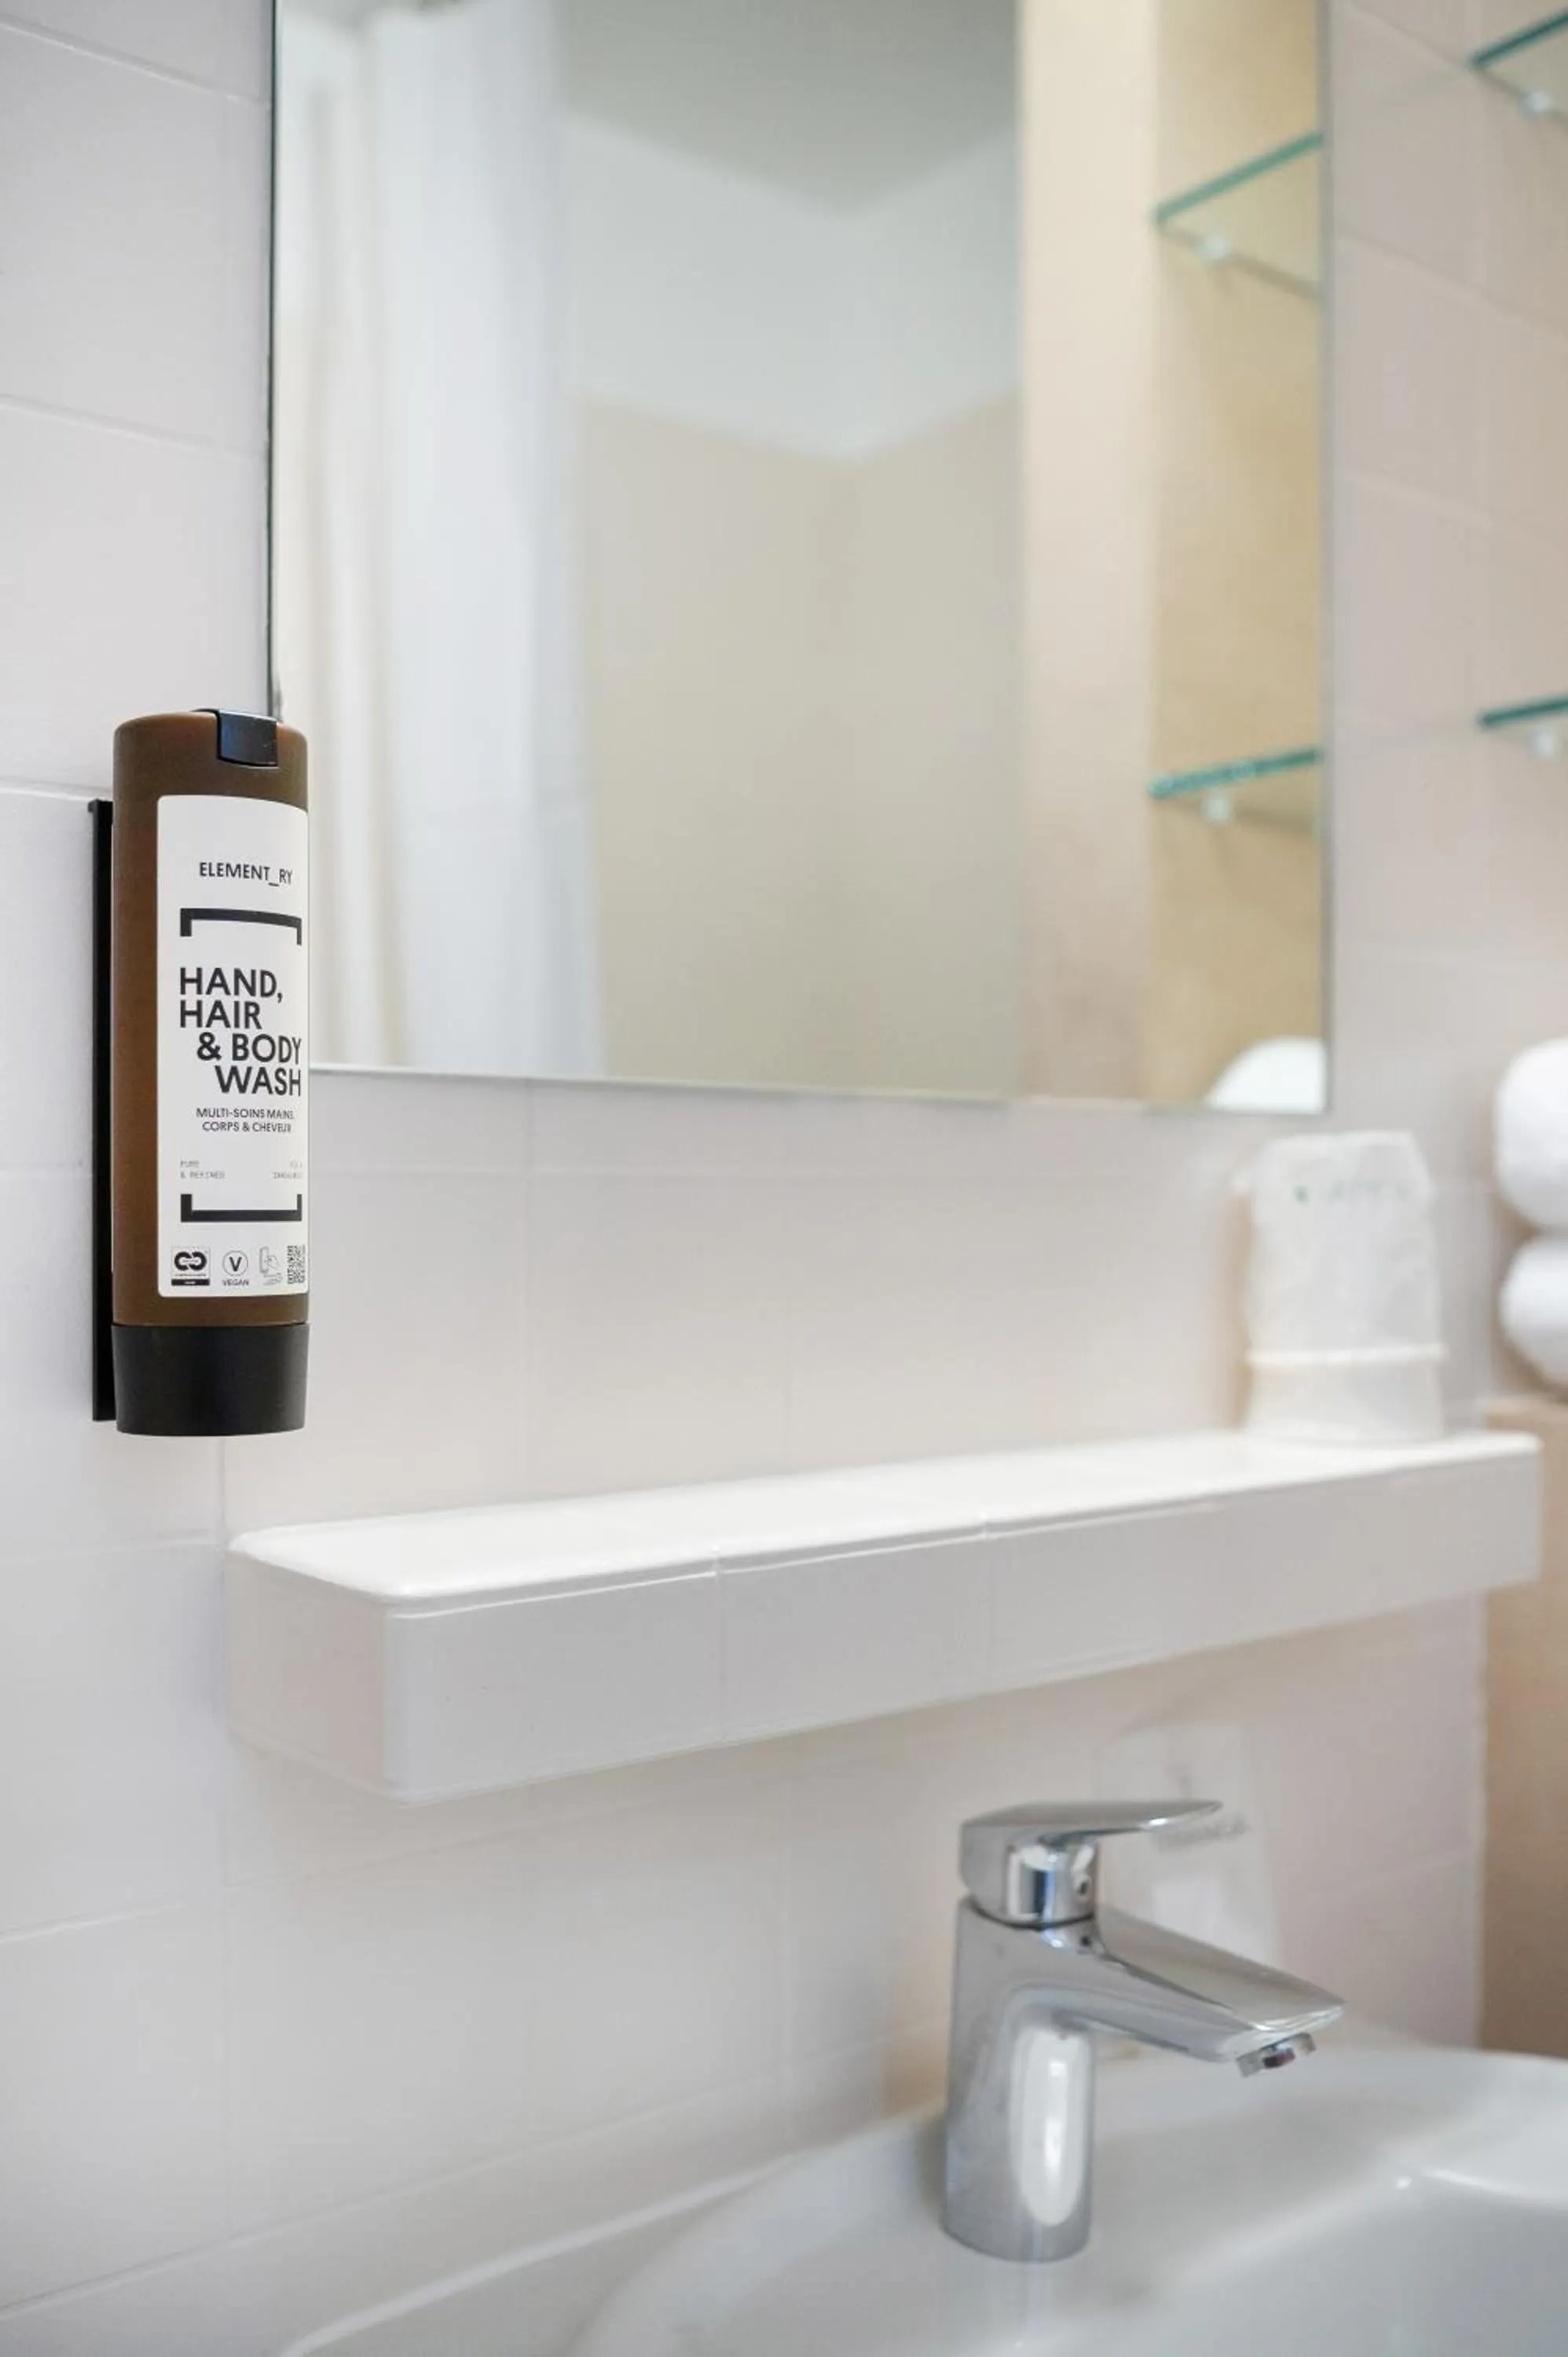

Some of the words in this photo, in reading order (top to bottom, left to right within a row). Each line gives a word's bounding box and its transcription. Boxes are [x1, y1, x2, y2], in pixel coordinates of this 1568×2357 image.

[200, 862, 292, 886] ELEMENT_RY
[180, 967, 283, 1003] HAND,
[180, 999, 262, 1029] HAIR
[196, 1032, 222, 1061] &
[232, 1033, 302, 1065] BODY
[214, 1065, 301, 1097] WASH
[196, 1107, 265, 1119] MULTI-SOINS
[202, 1121, 240, 1131] CORPS
[242, 1122, 250, 1132] &
[229, 1256, 242, 1272] V
